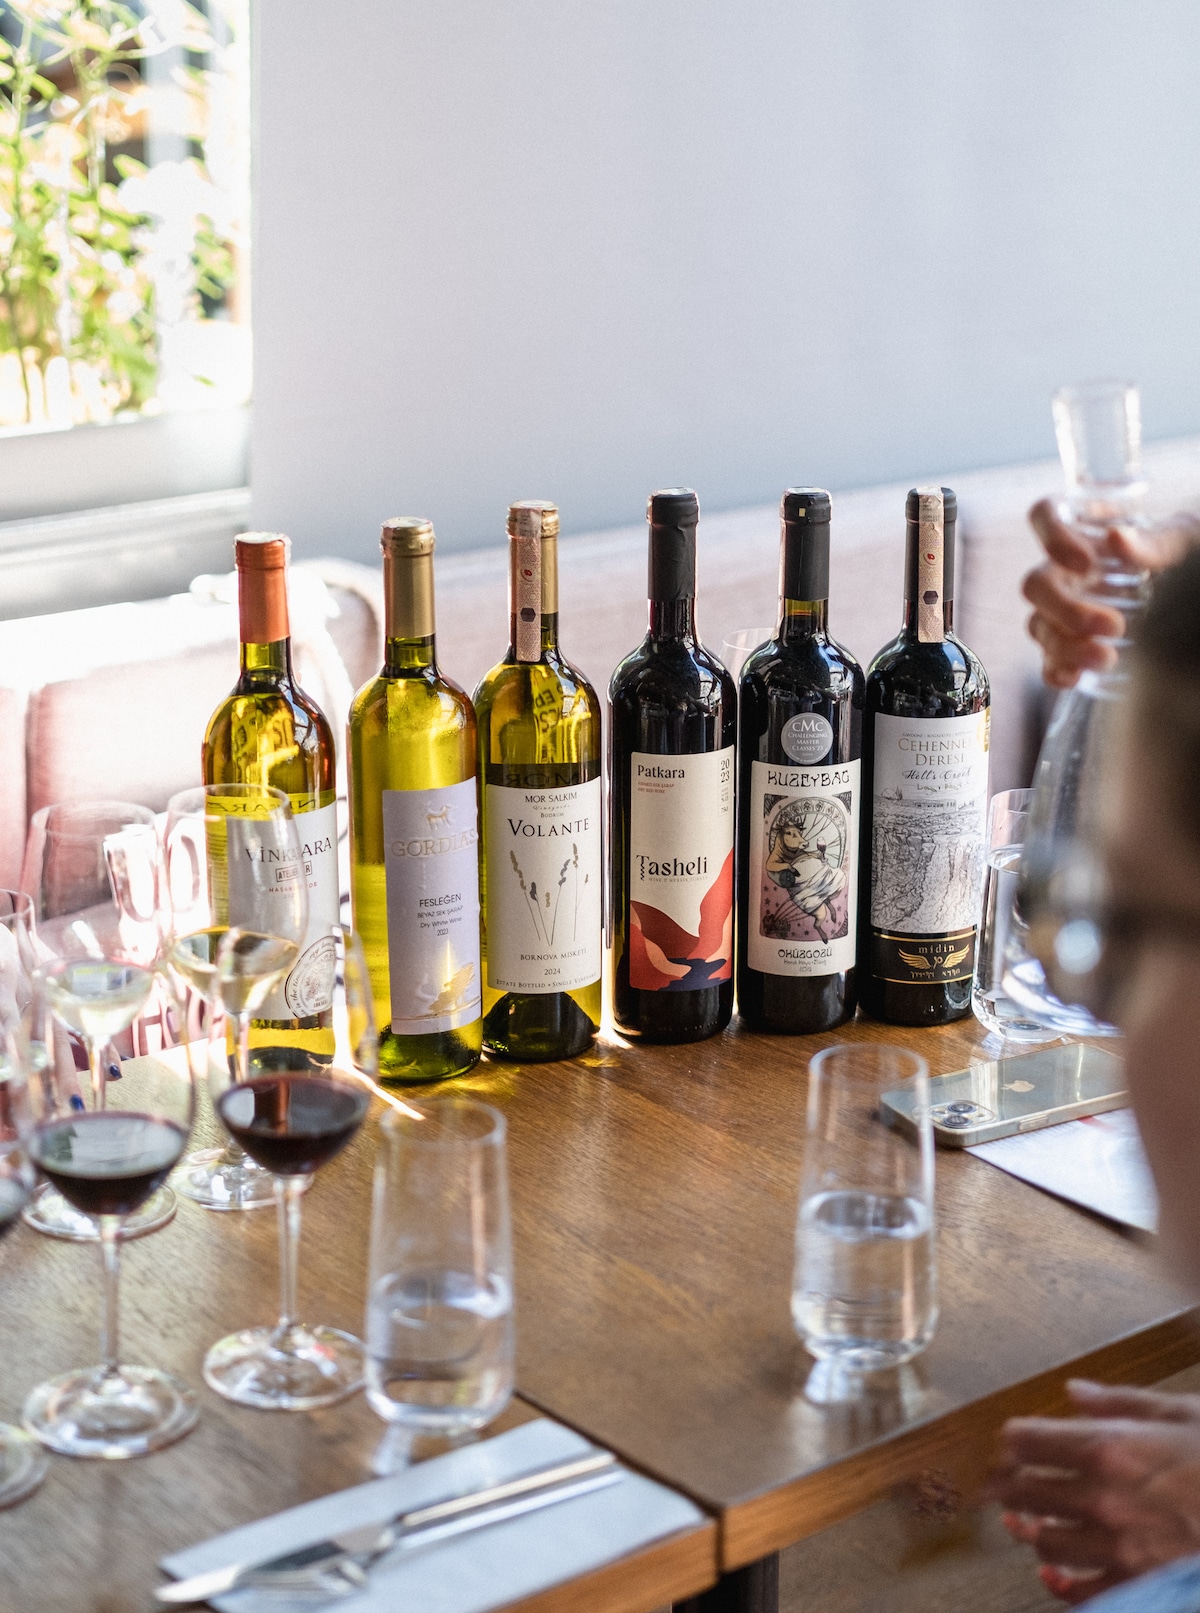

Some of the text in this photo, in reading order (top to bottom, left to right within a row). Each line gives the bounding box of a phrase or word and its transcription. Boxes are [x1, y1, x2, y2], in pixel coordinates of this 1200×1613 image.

[792, 719, 824, 732] CMC
[720, 758, 730, 770] 20
[637, 765, 685, 779] Patkara
[720, 770, 730, 783] 23
[524, 792, 577, 803] MOR SALKIM
[390, 828, 479, 858] GORDIAS
[636, 854, 708, 882] Tasheli
[419, 892, 461, 908] FESLEĞEN
[417, 911, 435, 919] BEYAZ
[432, 919, 448, 927] White
[449, 916, 462, 924] Wine
[437, 928, 449, 936] 2023
[918, 944, 955, 954] midin
[544, 968, 561, 976] 2024
[496, 979, 516, 987] ESTATE
[518, 980, 545, 988] BOTTLED
[552, 980, 572, 988] SINGLE
